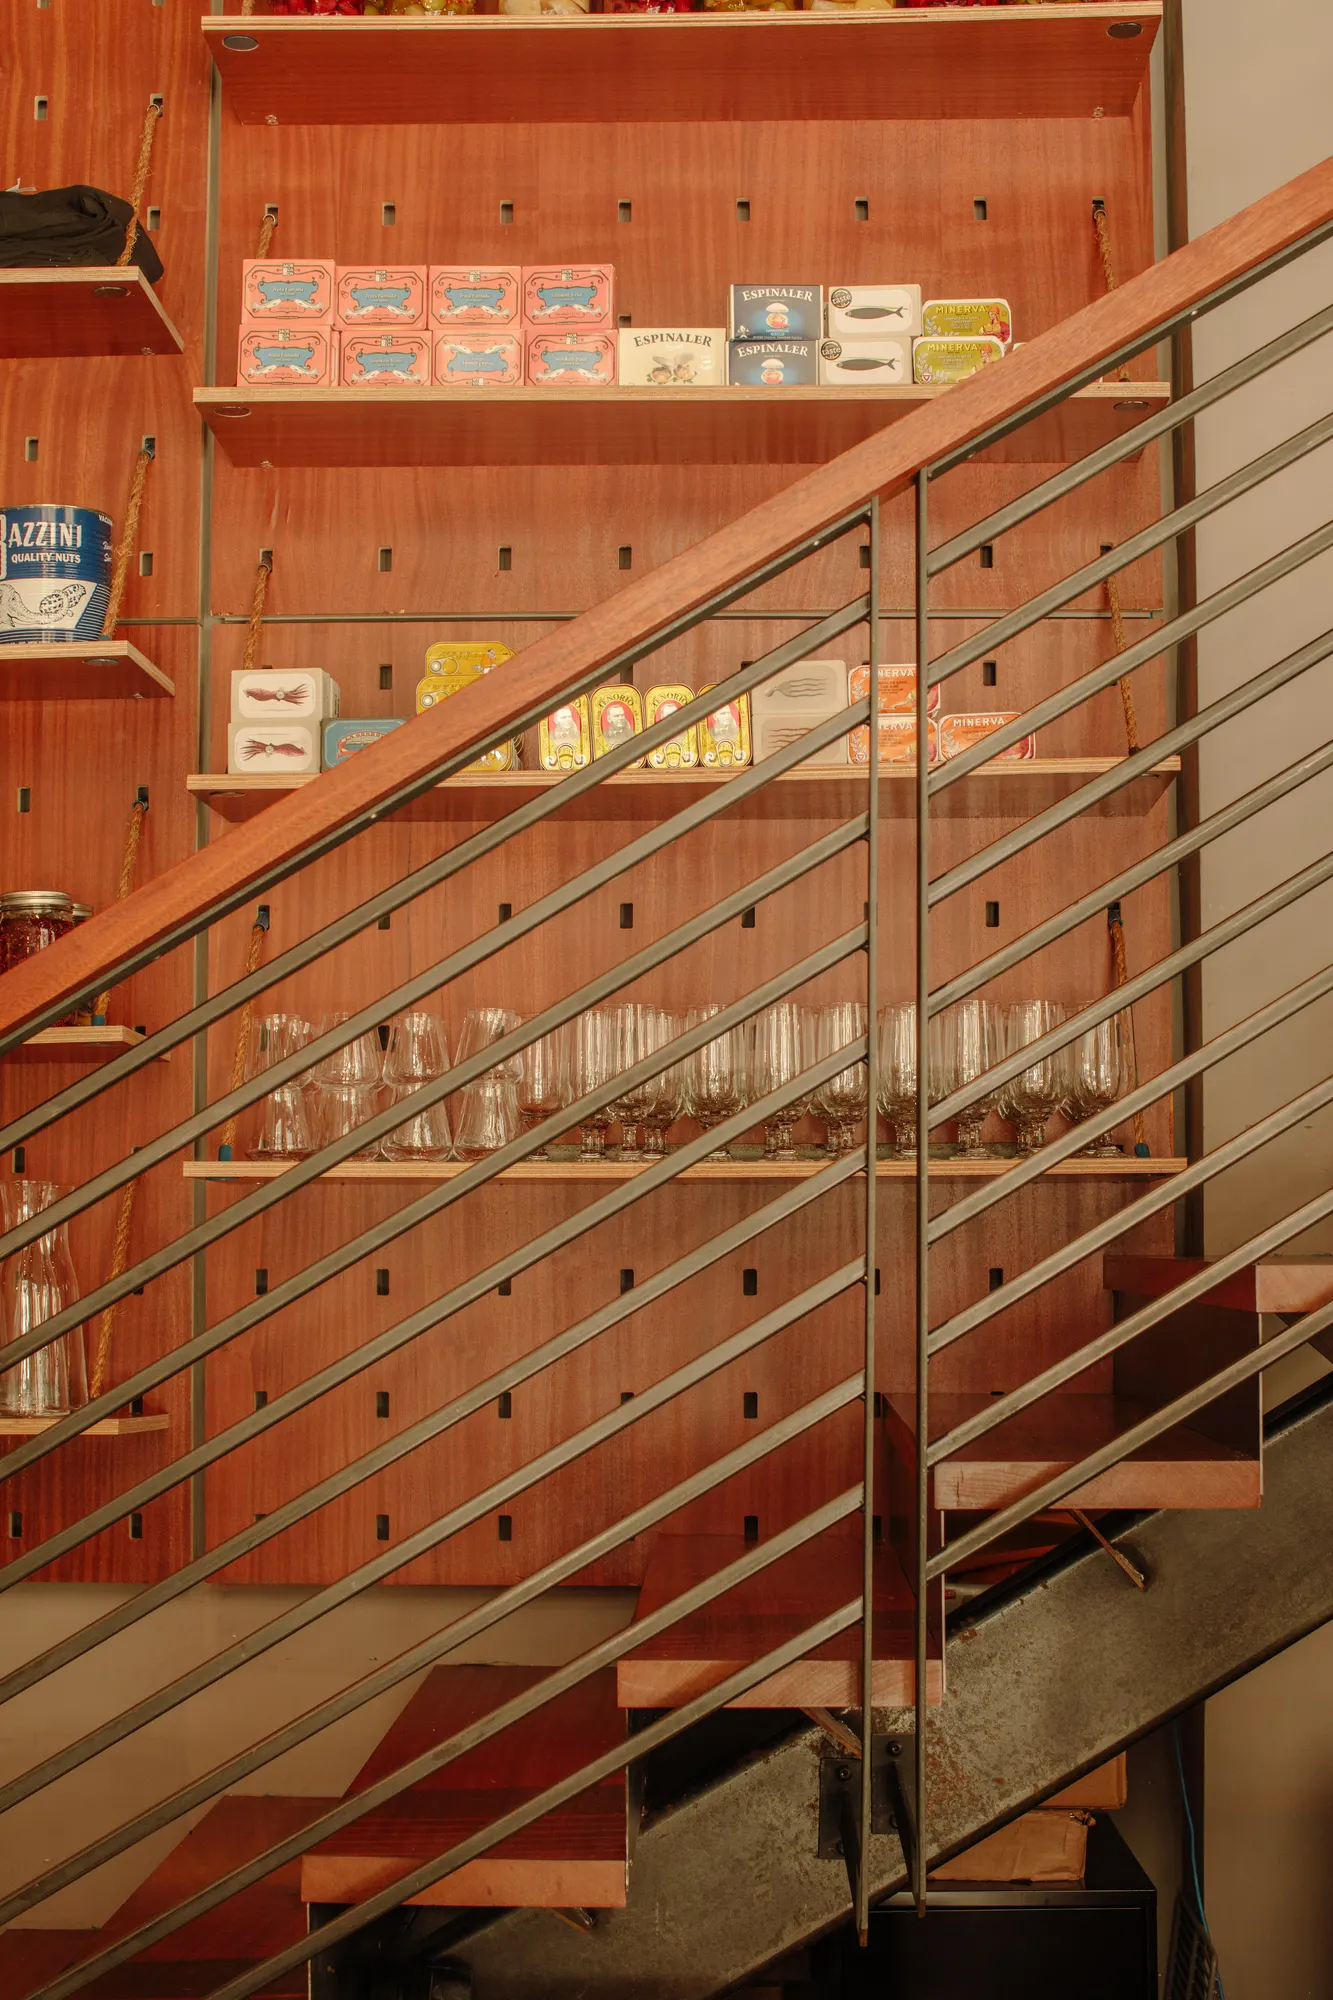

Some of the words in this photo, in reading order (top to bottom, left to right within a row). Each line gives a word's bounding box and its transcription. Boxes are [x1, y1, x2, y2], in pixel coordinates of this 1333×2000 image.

[742, 288, 813, 302] ESPINALER
[832, 294, 851, 305] taste
[935, 305, 986, 314] MINERVA
[633, 333, 712, 347] ESPINALER
[737, 344, 808, 358] ESPINALER
[822, 347, 841, 356] taste
[927, 343, 978, 352] MINERVA
[11, 552, 52, 563] QUALITY
[55, 553, 81, 563] NUTS
[863, 669, 914, 677] MNERVA
[598, 693, 634, 708] TENORIO
[652, 692, 688, 707] TENORIO
[861, 722, 913, 730] MNERVA
[953, 717, 1005, 727] MINERVA
